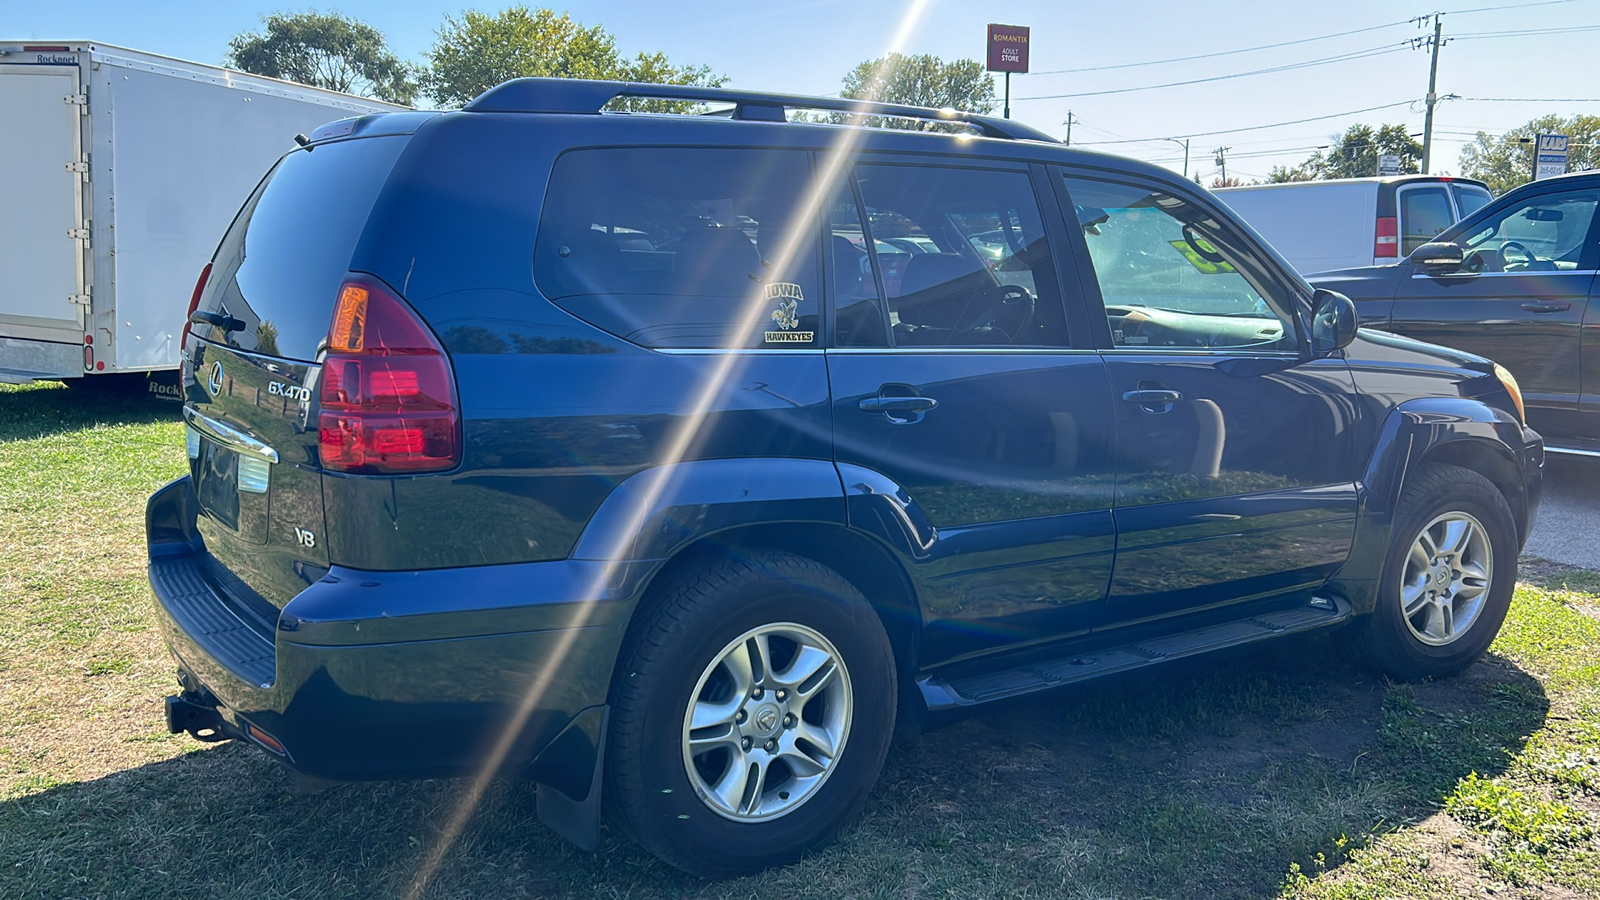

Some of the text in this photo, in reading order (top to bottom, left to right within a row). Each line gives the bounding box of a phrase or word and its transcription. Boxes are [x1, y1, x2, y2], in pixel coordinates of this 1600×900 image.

[993, 34, 1027, 43] ROMANTIX
[1001, 48, 1018, 56] ADULT
[1540, 136, 1567, 150] KARS
[1540, 166, 1562, 175] 265-0215
[765, 283, 803, 300] IOWA
[765, 332, 813, 342] HAWKEYES
[268, 381, 311, 402] GX470
[294, 527, 316, 548] V8
